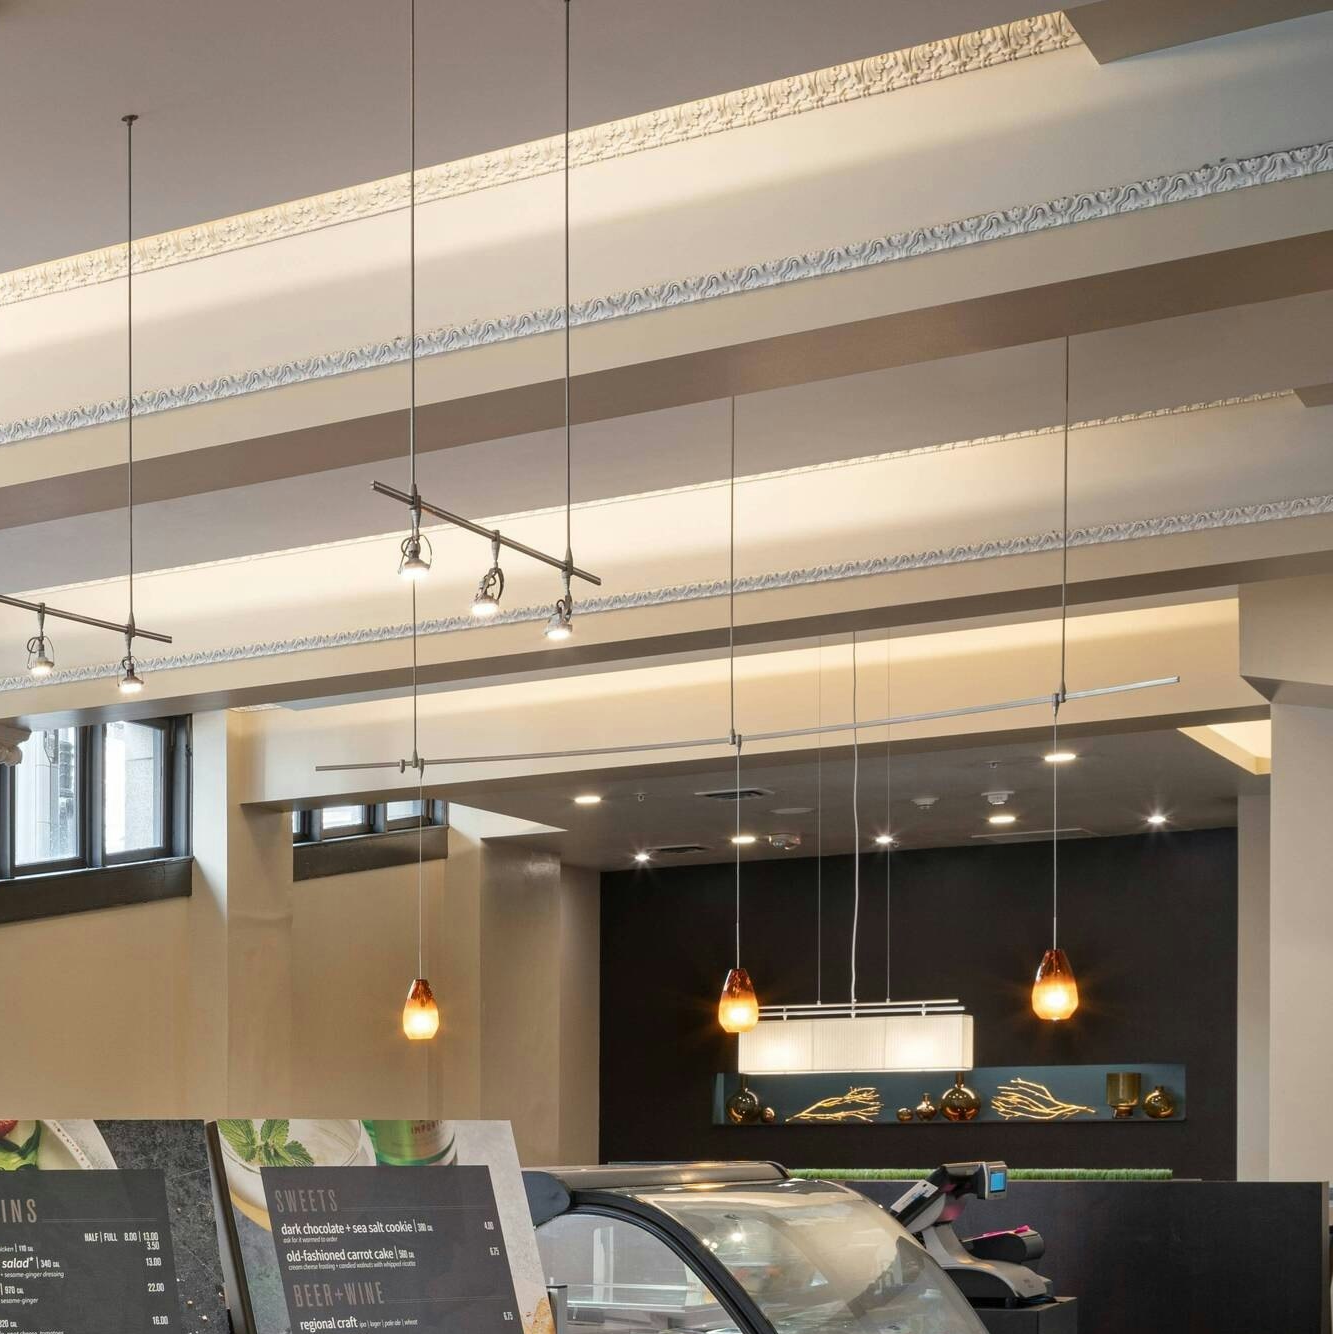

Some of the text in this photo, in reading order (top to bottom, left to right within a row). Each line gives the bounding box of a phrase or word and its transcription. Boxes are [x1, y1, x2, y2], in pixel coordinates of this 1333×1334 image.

[274, 1189, 338, 1213] SWEETS
[281, 1220, 413, 1236] dark chocolate sea salt cookie
[286, 1247, 394, 1262] old-fashioned carrot cake
[300, 1316, 358, 1333] regional craft
